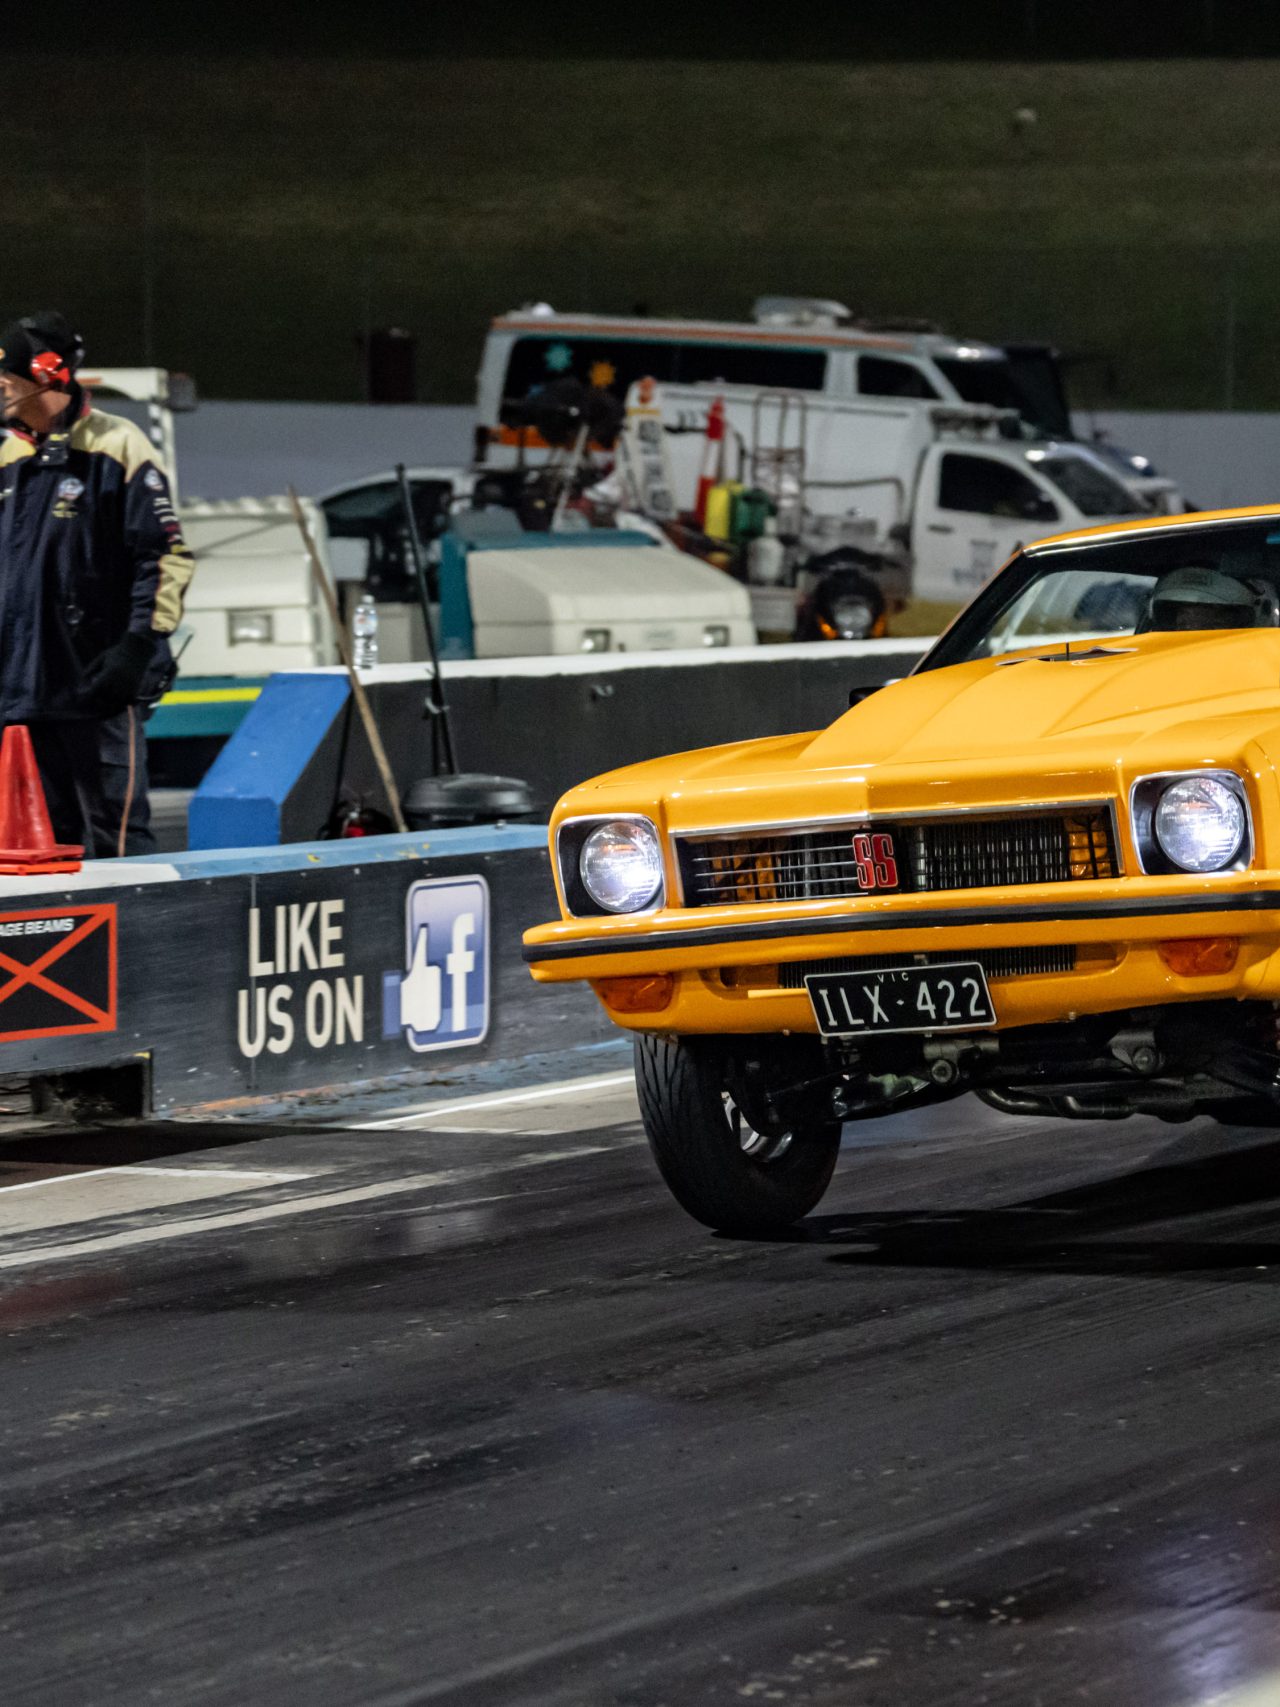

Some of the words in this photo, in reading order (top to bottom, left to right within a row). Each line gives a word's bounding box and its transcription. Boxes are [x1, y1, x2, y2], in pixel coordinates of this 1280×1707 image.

[852, 833, 899, 889] SS
[25, 918, 75, 935] BEAMS
[249, 899, 345, 977] LIKE
[877, 972, 909, 983] VIC
[238, 983, 295, 1058] US
[306, 975, 364, 1049] ON
